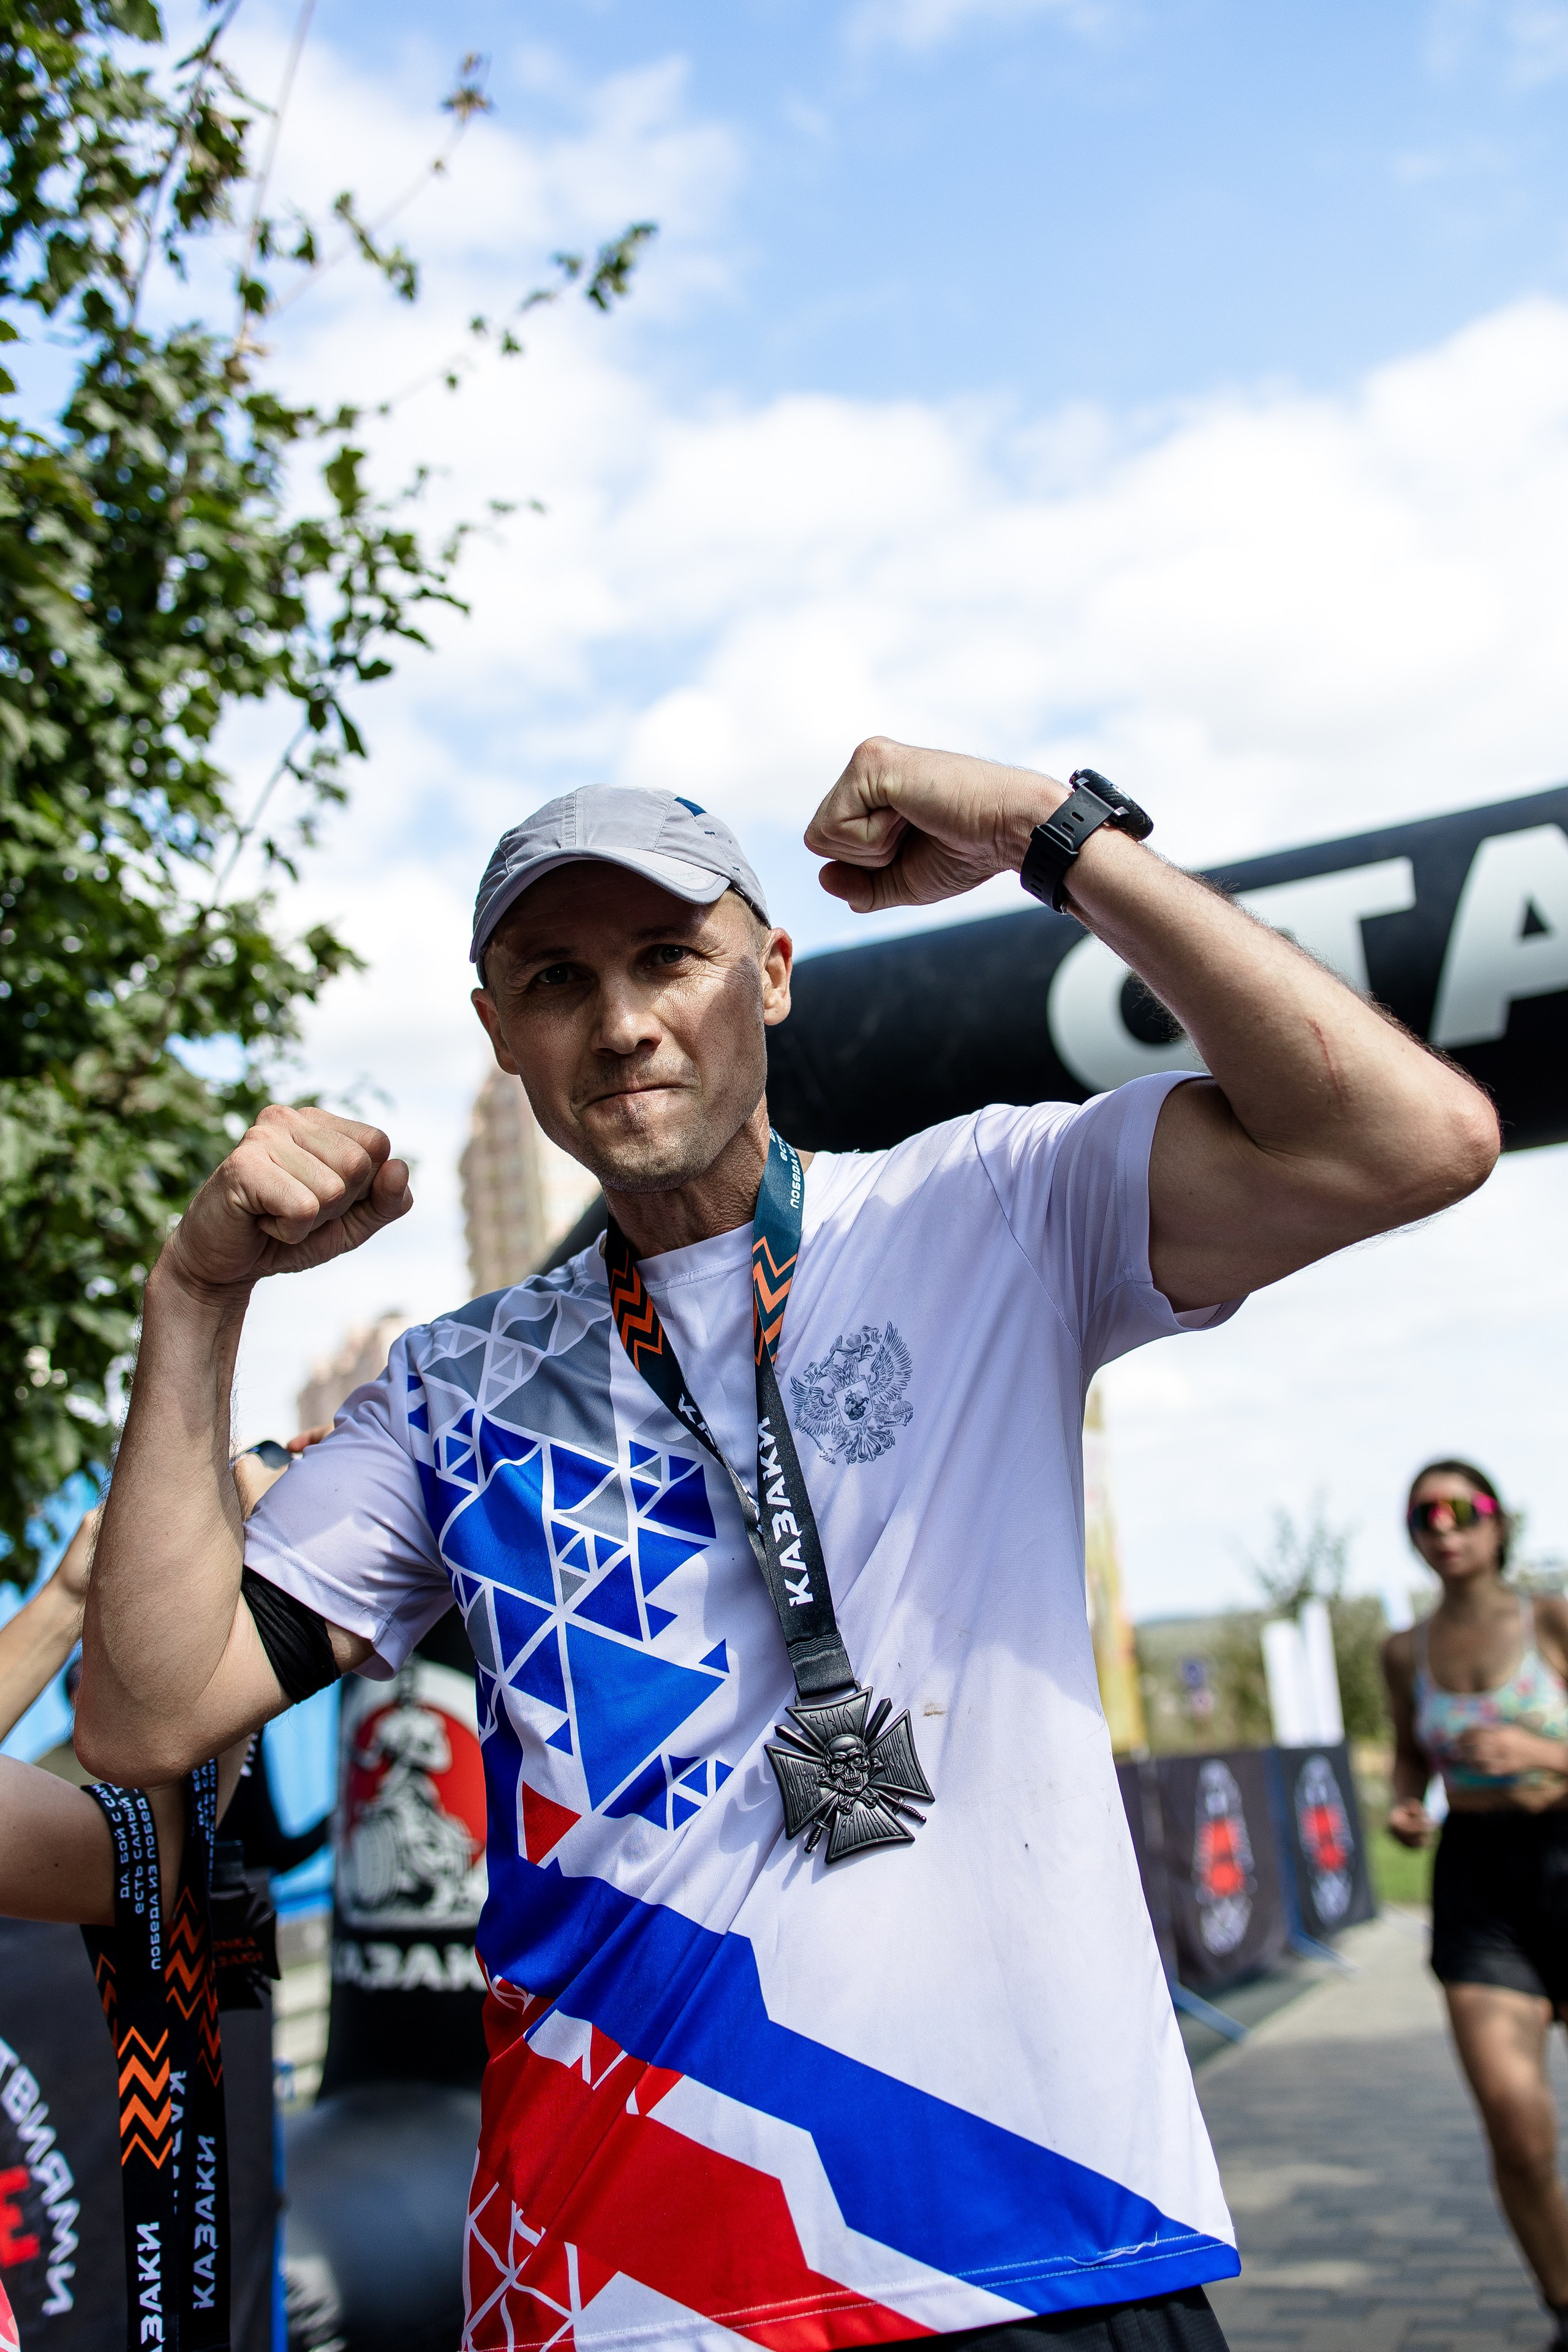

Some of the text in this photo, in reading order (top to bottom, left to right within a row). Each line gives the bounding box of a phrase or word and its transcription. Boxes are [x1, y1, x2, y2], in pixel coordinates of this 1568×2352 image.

[790, 1158, 801, 1209] ПОБЕДА
[758, 1417, 814, 1607] КАЗАКИ
[111, 1812, 122, 1822] С
[114, 1828, 129, 1864] БОЙ
[118, 1797, 145, 1914] ЕСТЬ САМЫЙ
[136, 1797, 161, 1970] ПОБЕДА ИЗ ПОБЕД
[192, 2135, 219, 2310] КАЗАКИ
